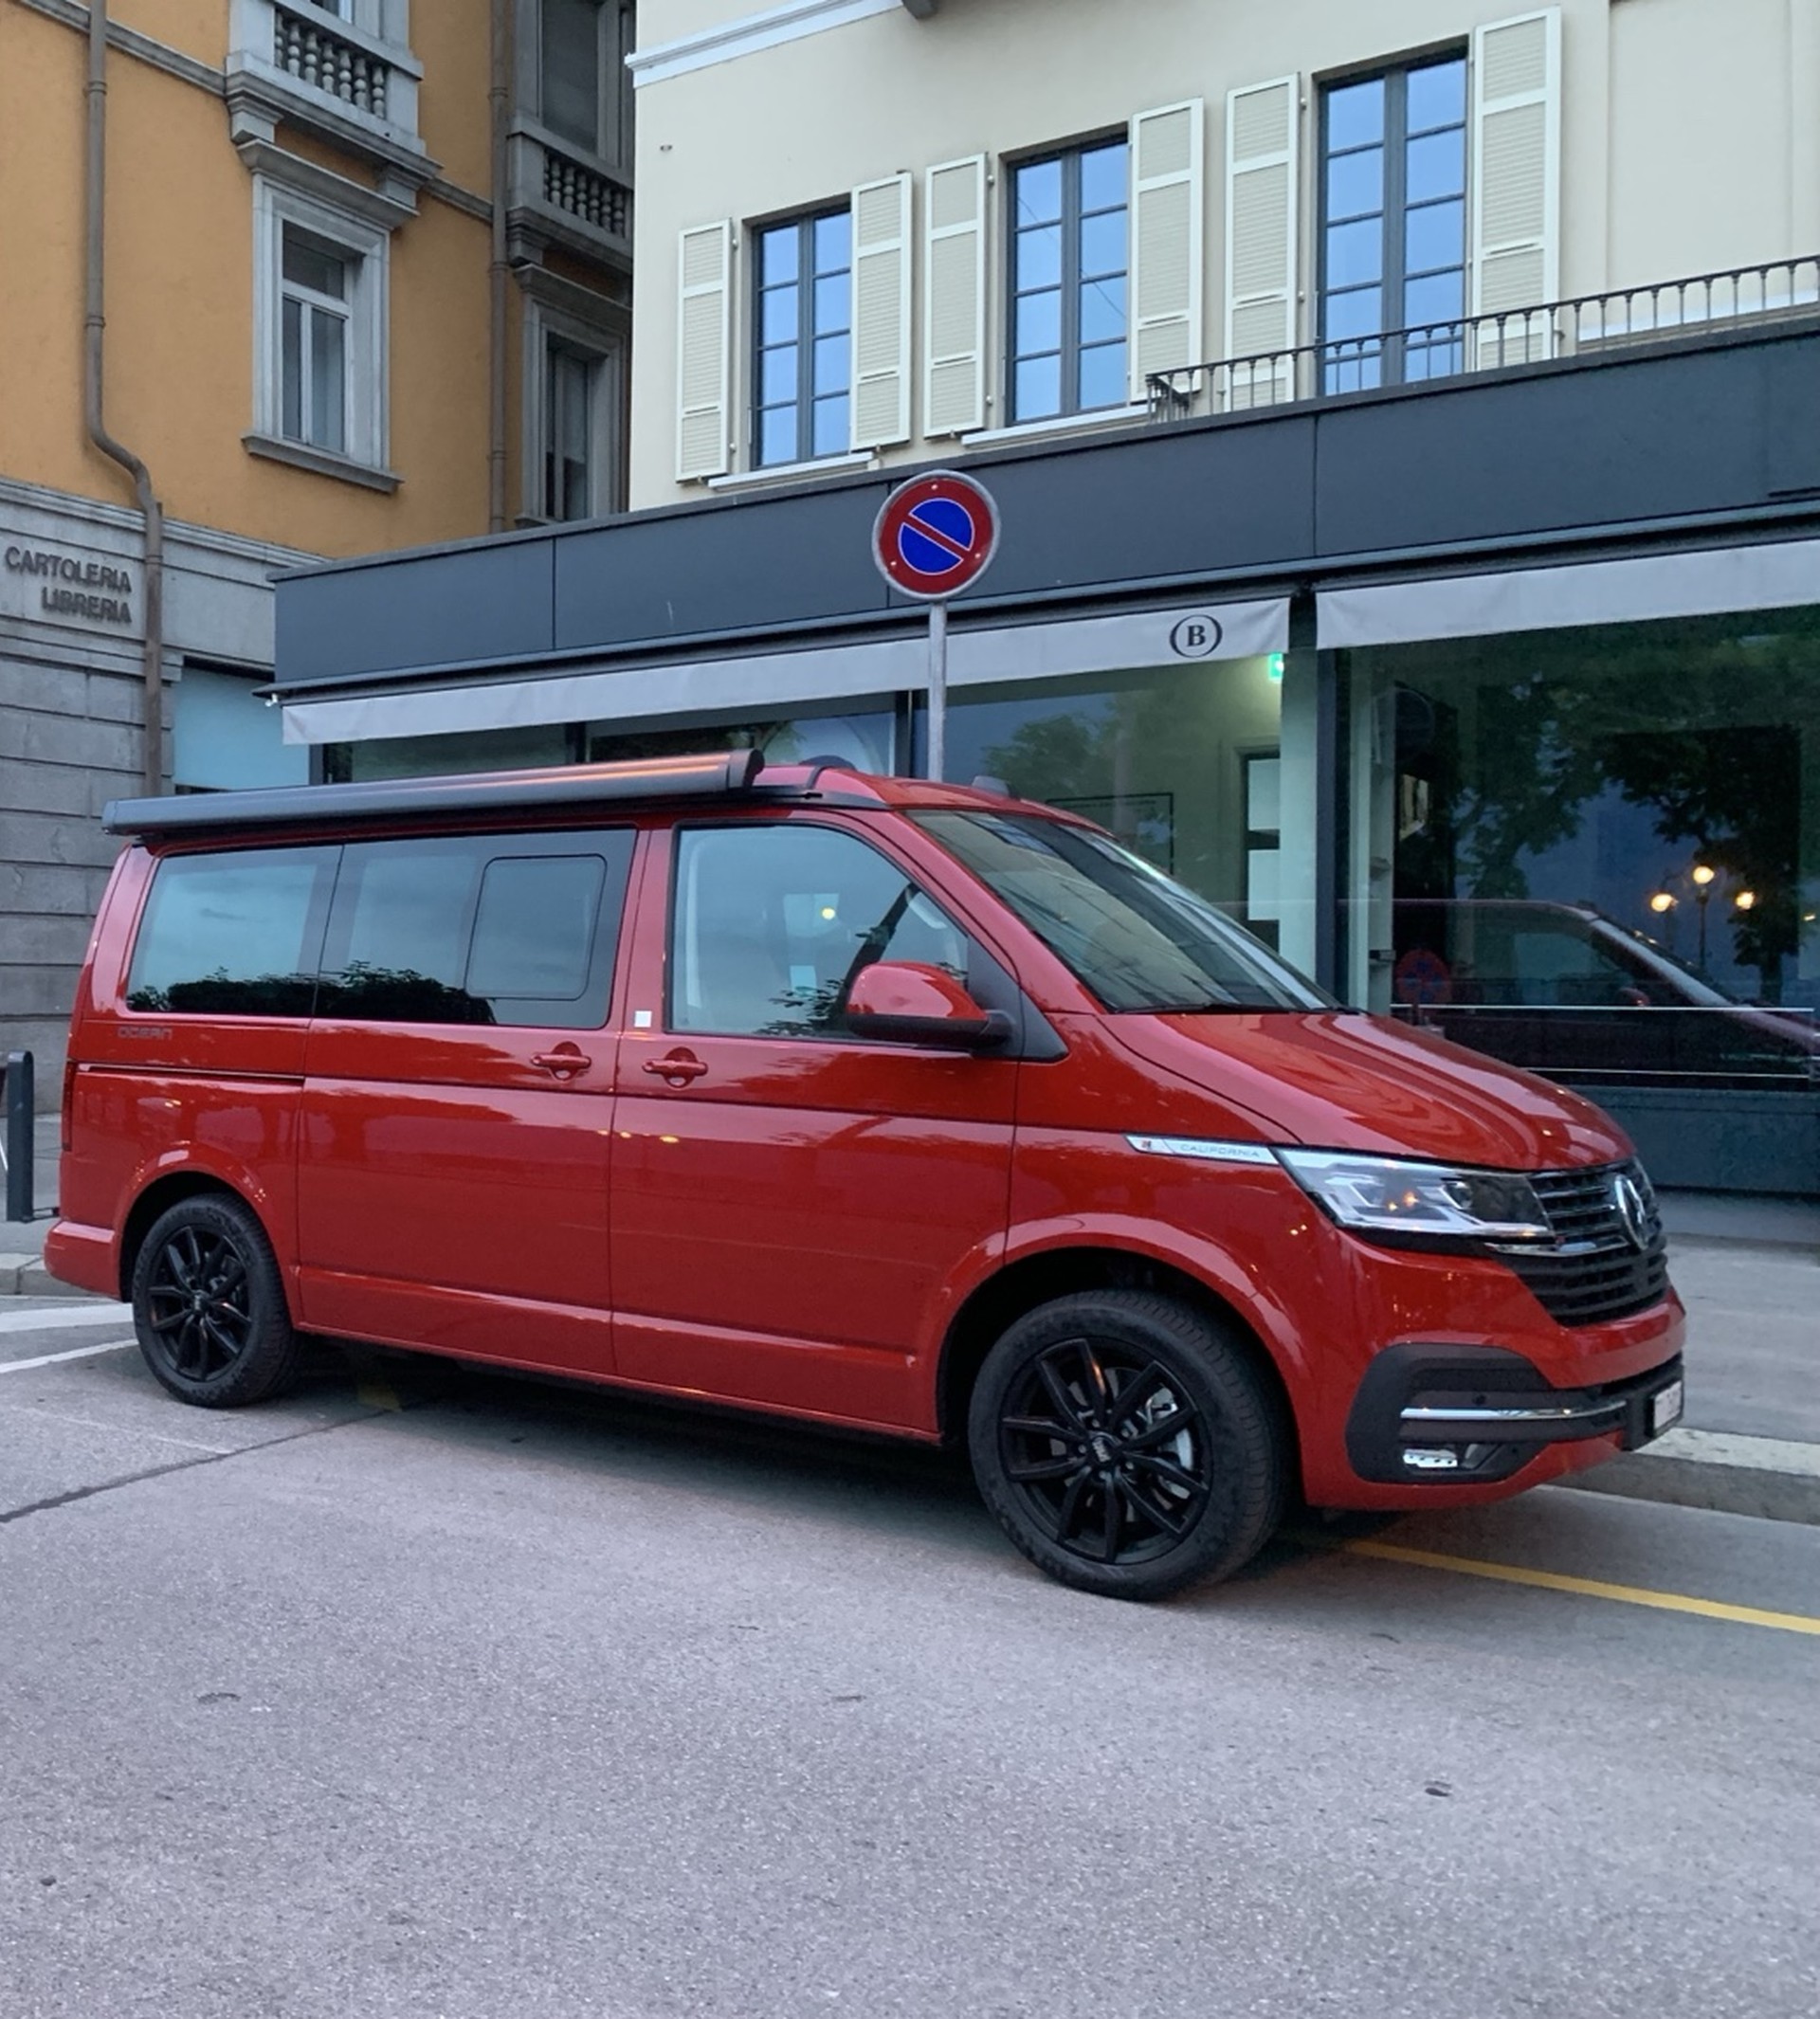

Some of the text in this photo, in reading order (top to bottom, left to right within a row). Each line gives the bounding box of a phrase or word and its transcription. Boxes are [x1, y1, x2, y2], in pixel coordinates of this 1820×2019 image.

[5, 546, 132, 593] CARTOLERIA
[42, 586, 132, 623] LIBRERIA
[1187, 625, 1206, 646] B
[1180, 1143, 1260, 1157] CALIFORNIA
